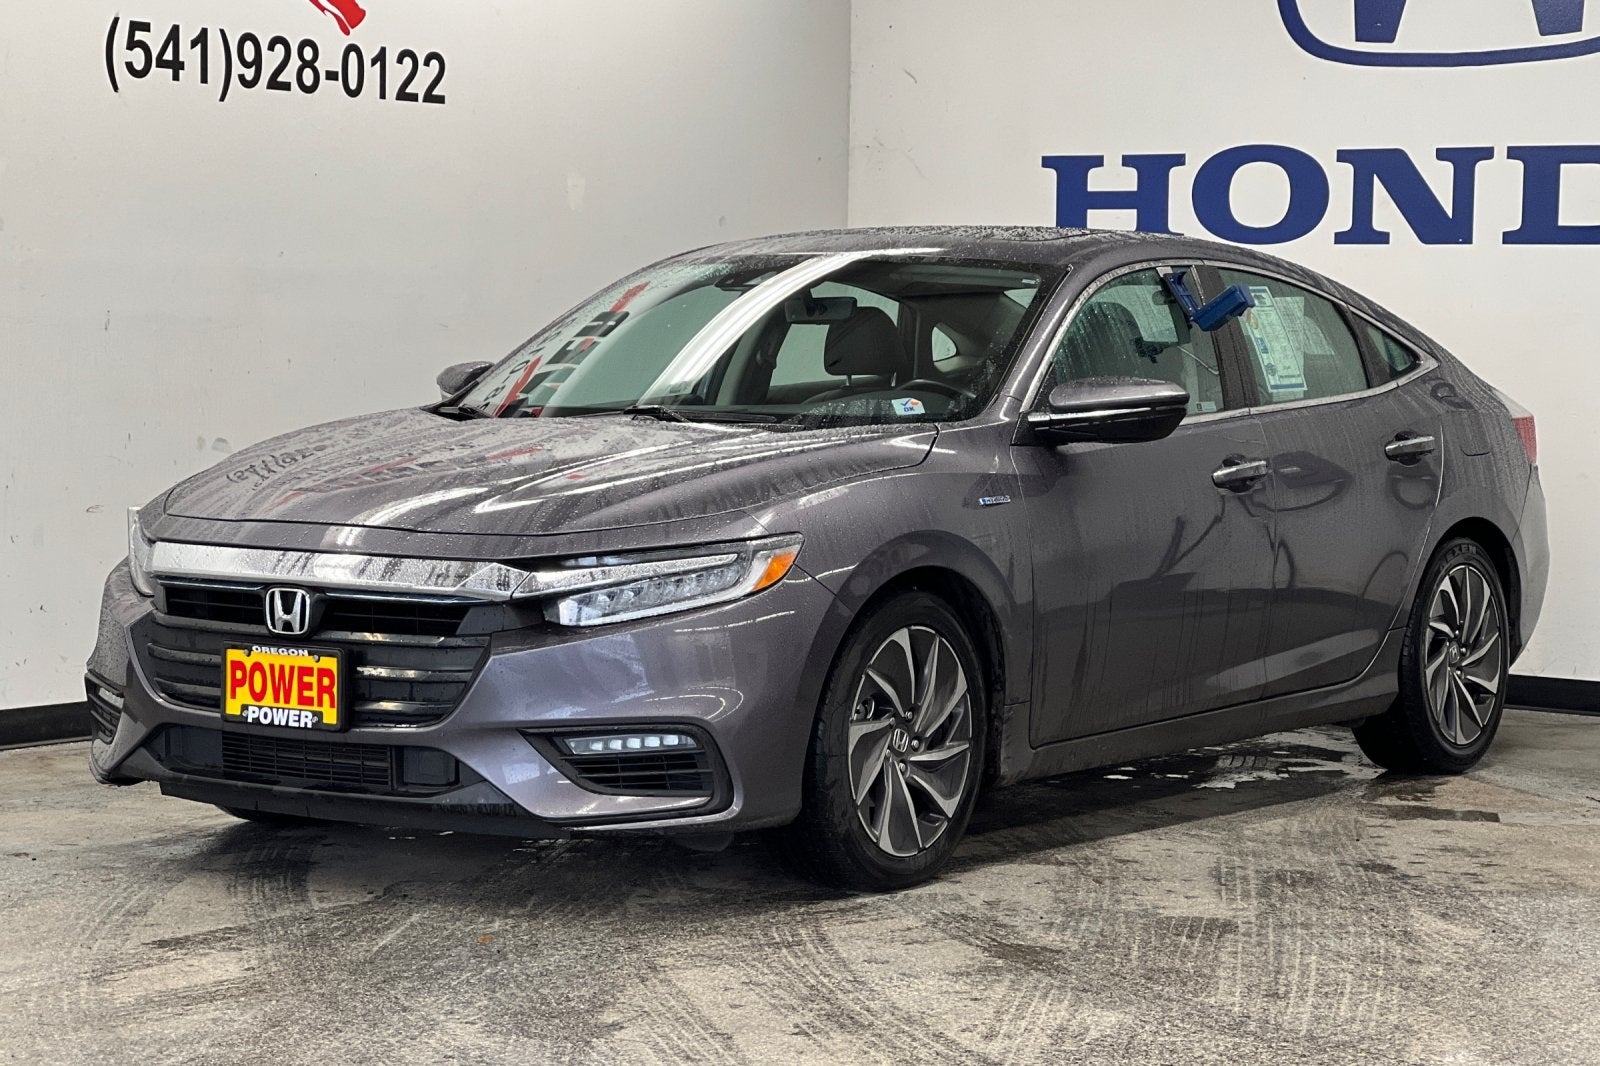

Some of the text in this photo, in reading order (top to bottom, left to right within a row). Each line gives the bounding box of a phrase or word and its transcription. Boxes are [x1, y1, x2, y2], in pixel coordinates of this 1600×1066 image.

[105, 16, 446, 104] (541)928-0122
[1041, 144, 1600, 245] HOND
[251, 645, 309, 657] OREGON
[230, 660, 336, 709] POWER
[247, 705, 313, 728] POWER
